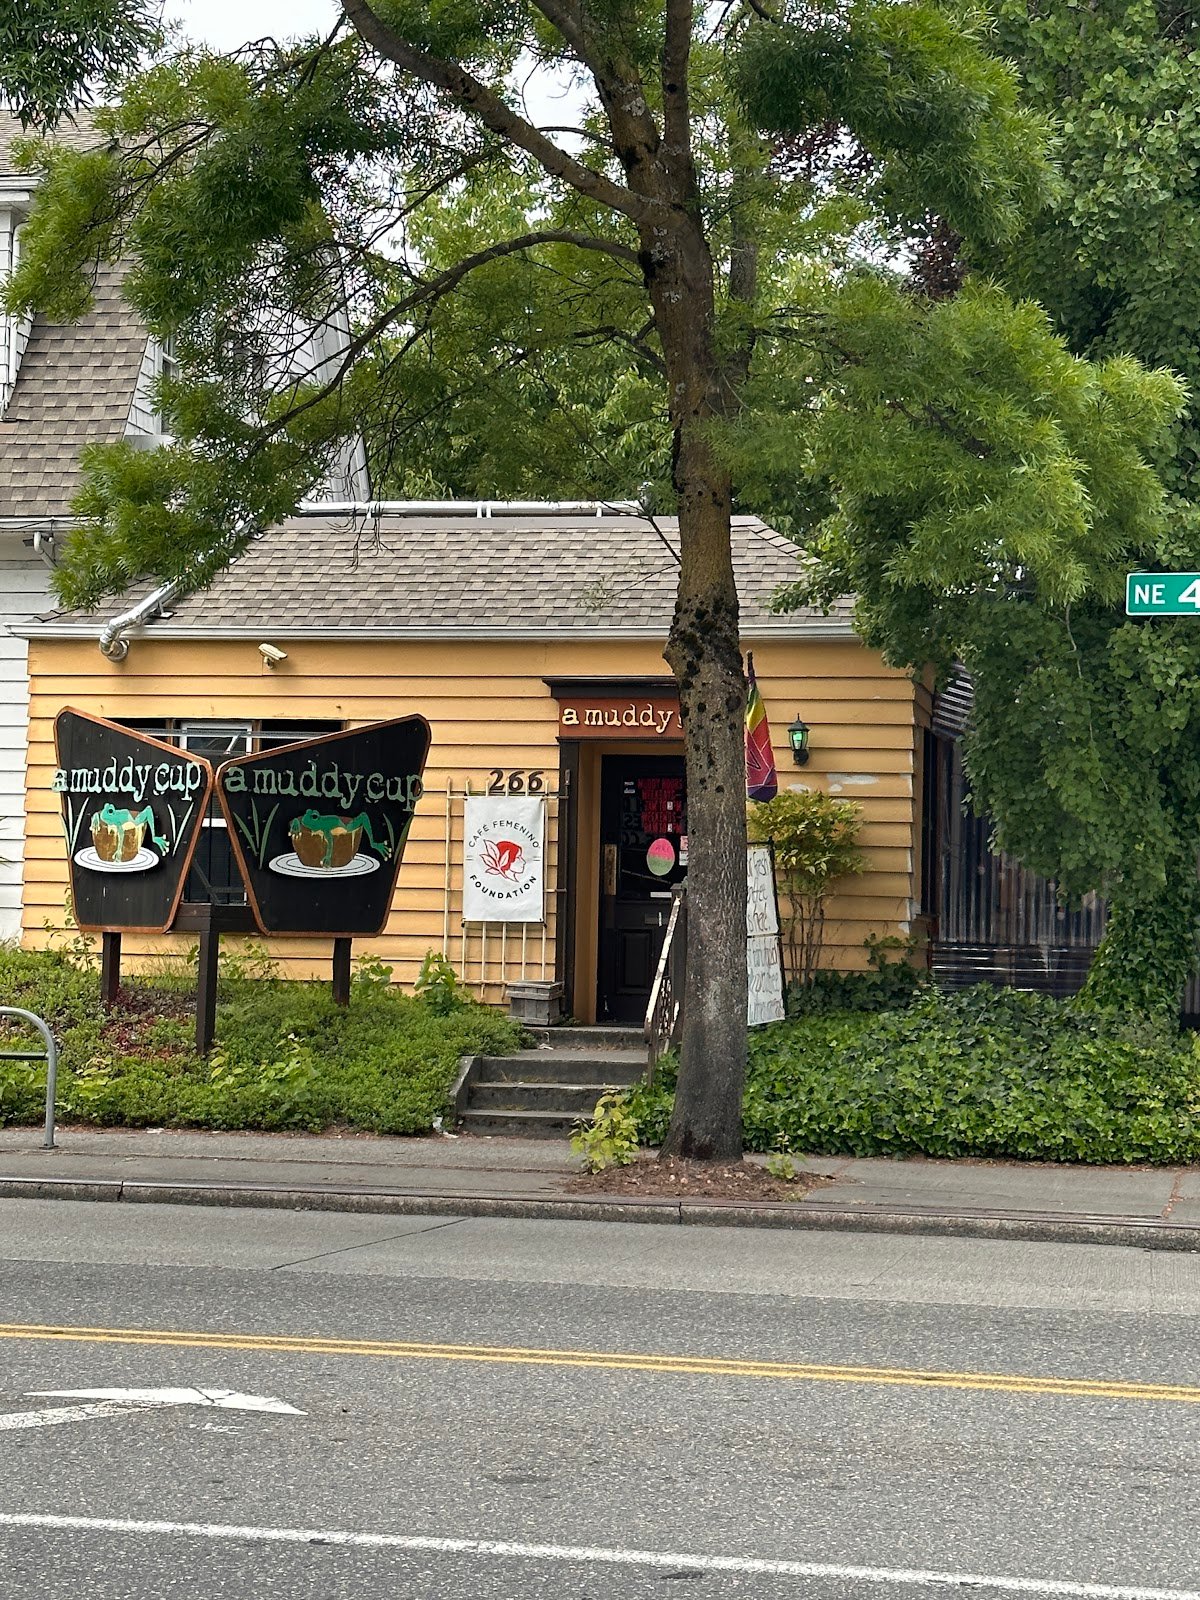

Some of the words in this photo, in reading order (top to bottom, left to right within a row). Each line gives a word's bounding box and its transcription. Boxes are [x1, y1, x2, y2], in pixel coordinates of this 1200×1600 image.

[1134, 583, 1166, 605] NE
[562, 707, 580, 726] a
[584, 702, 674, 734] muddy
[51, 768, 69, 793] a
[70, 756, 152, 802] muddy
[153, 762, 201, 801] cup
[224, 766, 248, 793] a
[252, 759, 364, 809] muddy
[365, 772, 425, 812] cup
[489, 768, 544, 792] 266
[492, 819, 540, 848] FEMENINO
[469, 874, 537, 899] FOUNDATION
